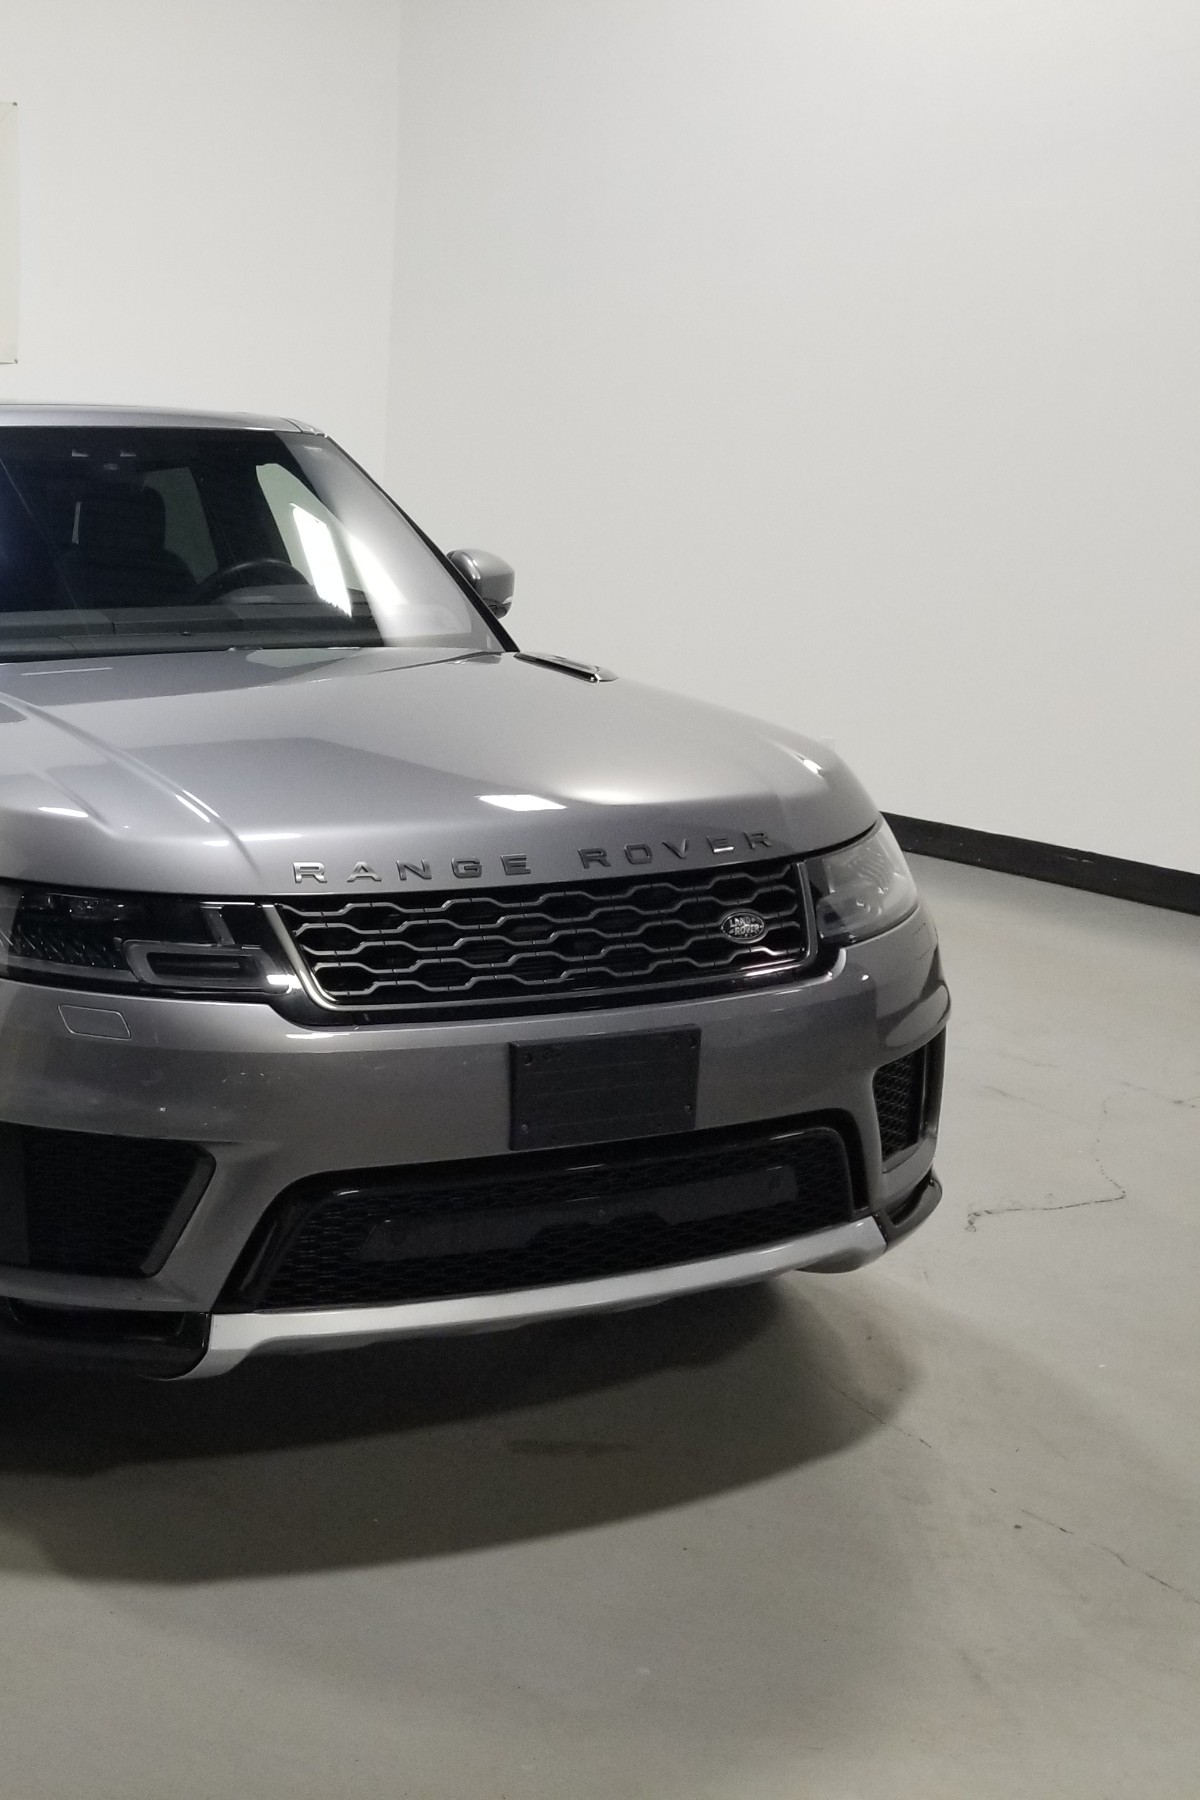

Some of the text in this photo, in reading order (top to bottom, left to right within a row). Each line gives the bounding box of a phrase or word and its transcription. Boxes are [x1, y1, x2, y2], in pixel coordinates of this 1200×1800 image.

[292, 831, 773, 884] RANGE ROVER
[734, 923, 760, 936] ROVER
